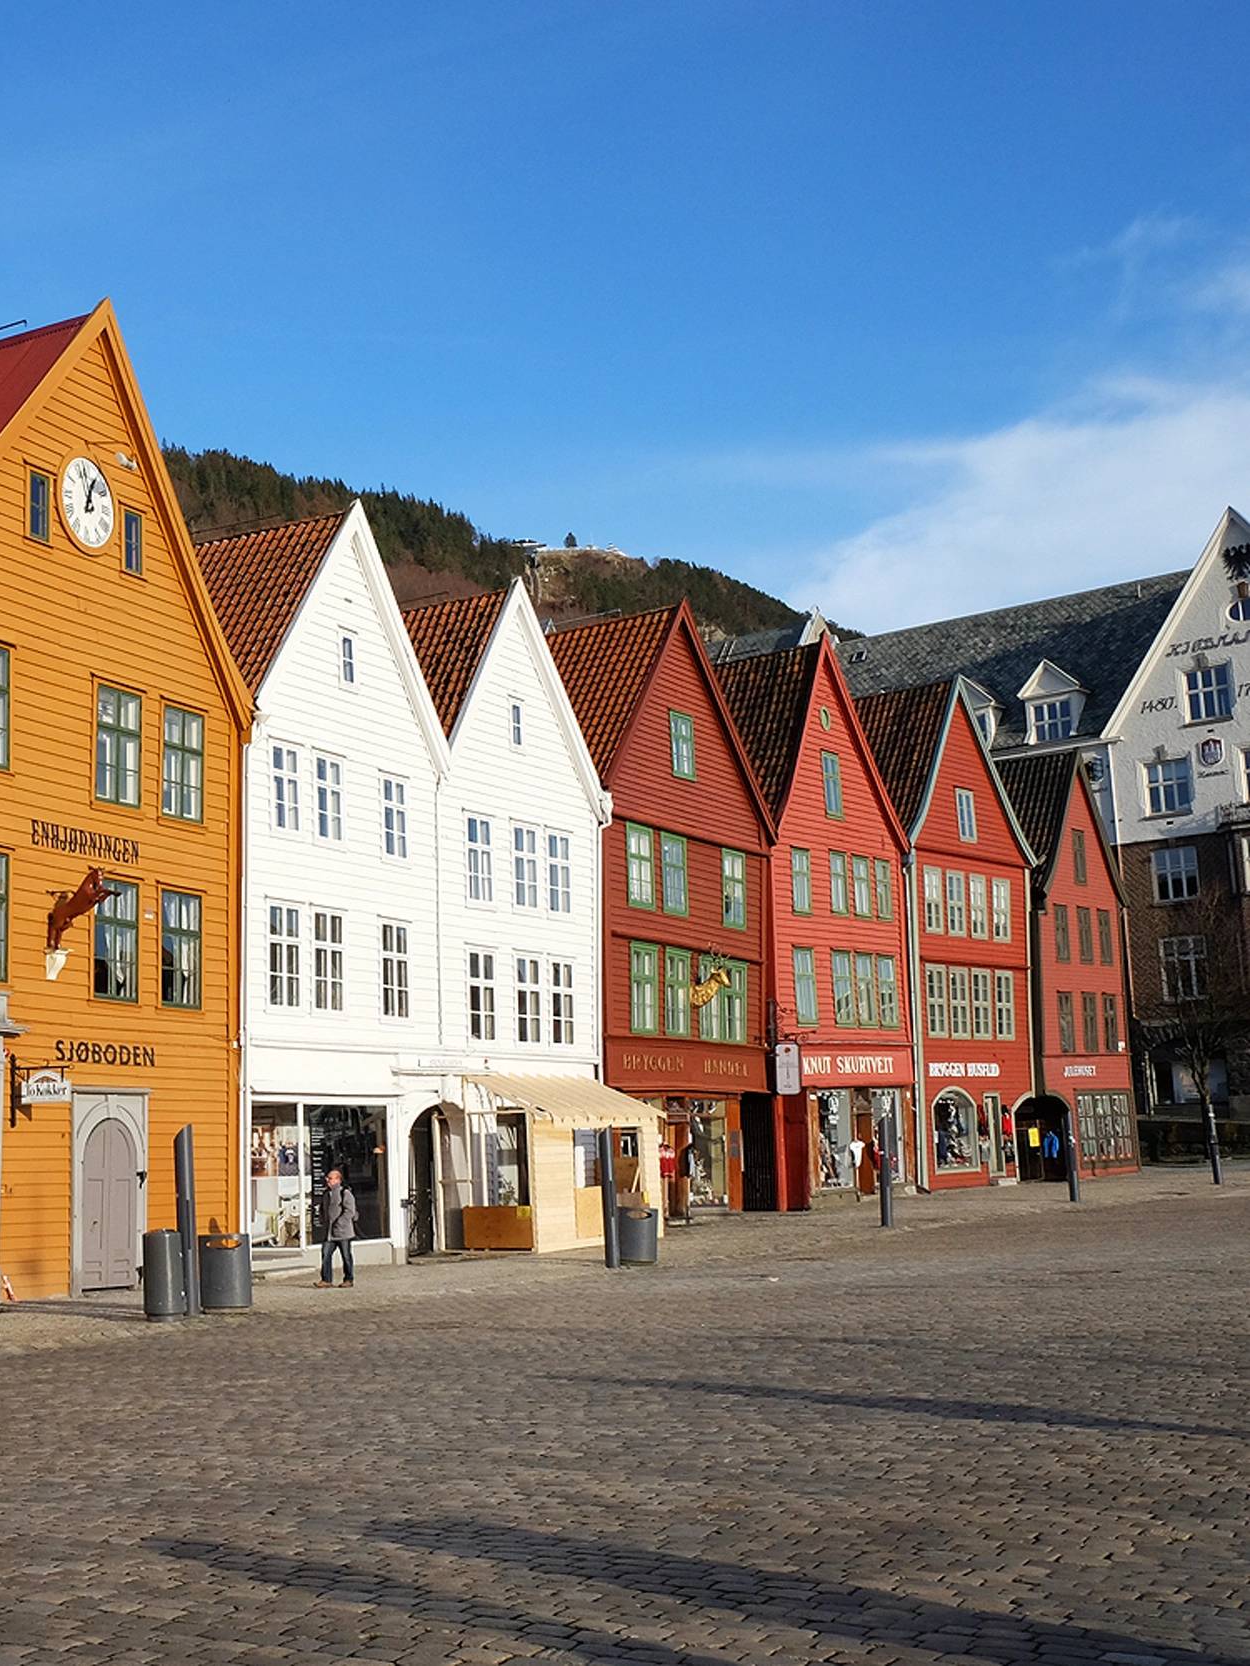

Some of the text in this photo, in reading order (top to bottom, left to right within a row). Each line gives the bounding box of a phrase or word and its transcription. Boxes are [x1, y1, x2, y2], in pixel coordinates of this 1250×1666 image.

[54, 1039, 155, 1067] SJØBODEN
[622, 1053, 685, 1073] BRYGGEN
[802, 1055, 831, 1075] KNUT
